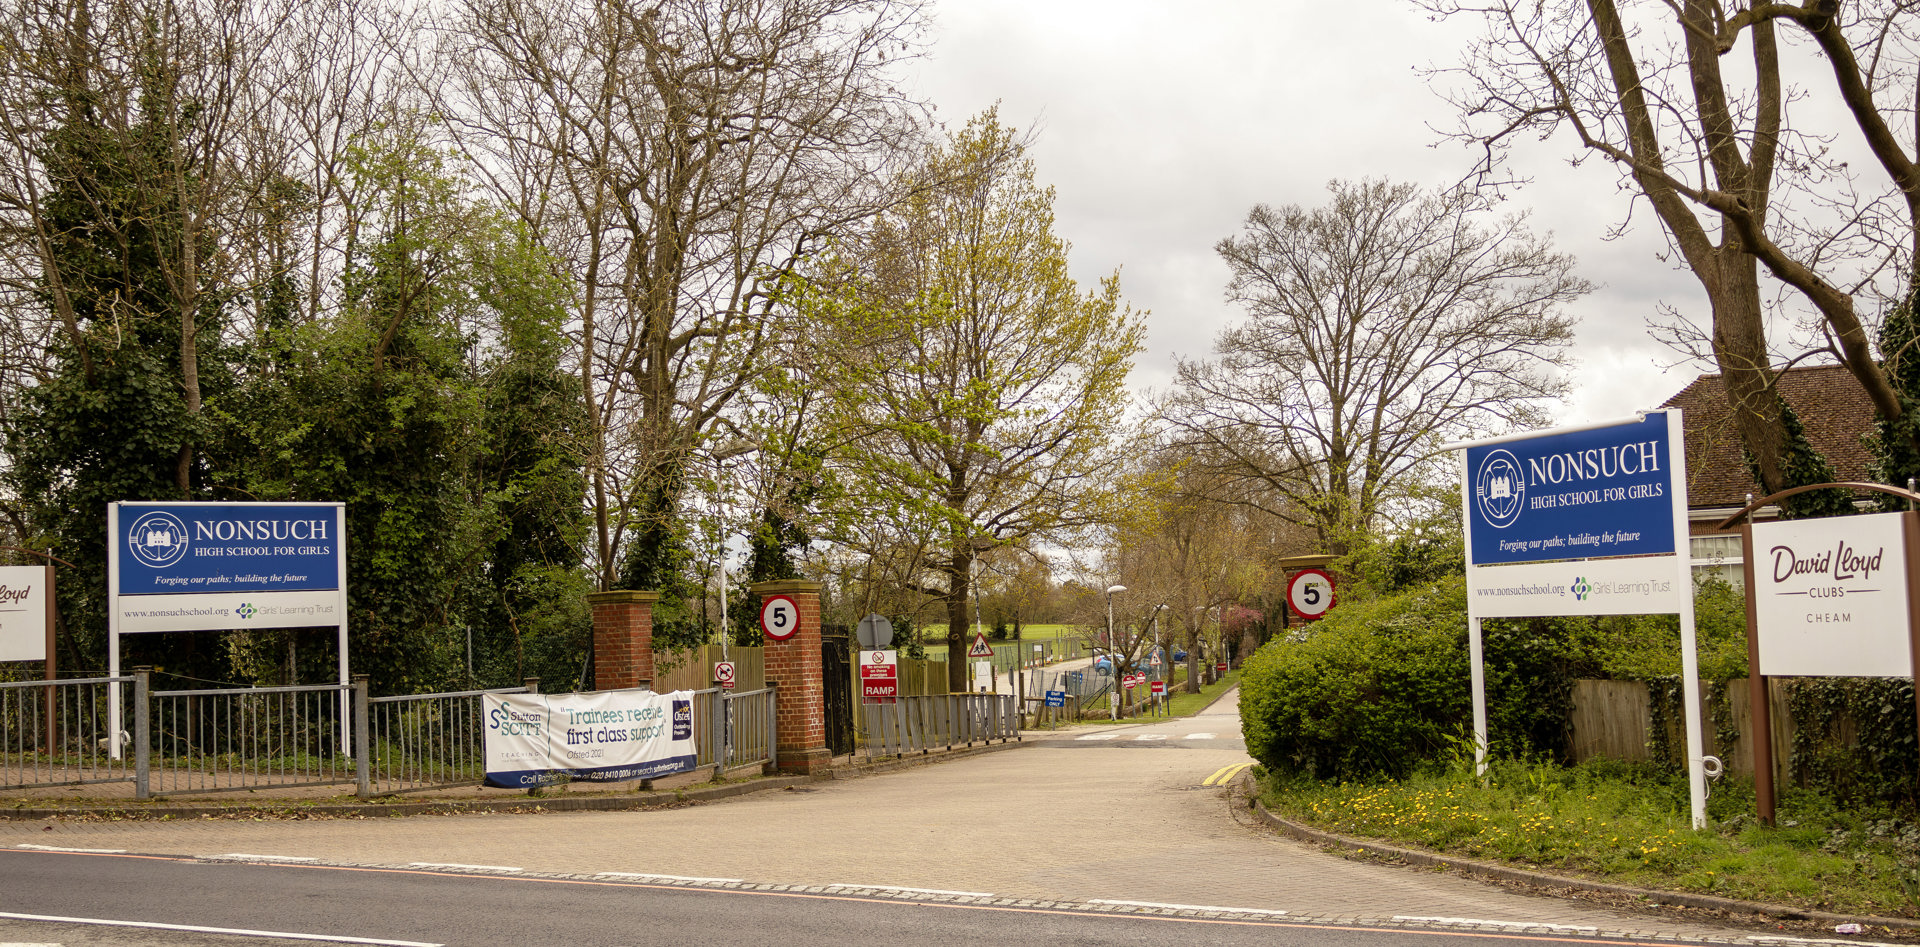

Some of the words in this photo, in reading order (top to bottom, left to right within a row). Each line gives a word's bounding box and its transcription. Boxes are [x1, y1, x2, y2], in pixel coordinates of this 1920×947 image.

[1528, 440, 1661, 487] NONSUCH
[1530, 494, 1557, 510] HIGH
[1558, 490, 1602, 507] SCHOOL
[1603, 487, 1628, 502] FOR
[1628, 482, 1663, 500] GIRLS
[193, 519, 329, 541] NONSUCH
[1499, 539, 1528, 553] Forging
[1528, 539, 1542, 549] our
[1542, 535, 1566, 551] paths;
[1568, 532, 1600, 547] building
[1601, 531, 1615, 544] the
[1615, 529, 1641, 546] future
[194, 546, 224, 557] HIGH
[226, 546, 272, 556] SCHOOL
[274, 546, 296, 556] FOR
[297, 545, 330, 556] GIRLS
[1770, 544, 1832, 584] David
[1834, 540, 1884, 581] Lloyd
[154, 575, 189, 586] Forging
[190, 576, 206, 584] our
[206, 574, 233, 586] paths;
[234, 573, 268, 585] building
[269, 573, 283, 583] the
[282, 573, 308, 584] future
[1613, 580, 1649, 596] Learning
[1650, 579, 1671, 593] Trust
[0, 584, 31, 605] loyd
[1303, 582, 1320, 606] 5
[1477, 583, 1565, 598] www.nonsuchschool.org
[1808, 586, 1845, 599] CLUBS
[124, 606, 230, 618] www.nonsuchschool.org
[279, 604, 315, 616] Learning
[315, 603, 334, 614] Trust
[773, 607, 787, 628] 5
[1806, 612, 1851, 624] CHEAM
[865, 686, 895, 695] RAMP
[510, 711, 541, 722] Sutton
[626, 703, 664, 722] receive
[501, 721, 541, 737] SCITT
[566, 727, 594, 745] first
[597, 726, 628, 744] class
[566, 750, 590, 760] Ofsted
[590, 748, 605, 759] 2021
[520, 774, 537, 785] Call
[590, 770, 604, 780] 020
[604, 770, 619, 780] 8410
[618, 768, 632, 779] 0006
[631, 769, 638, 777] or
[637, 765, 654, 776] search
